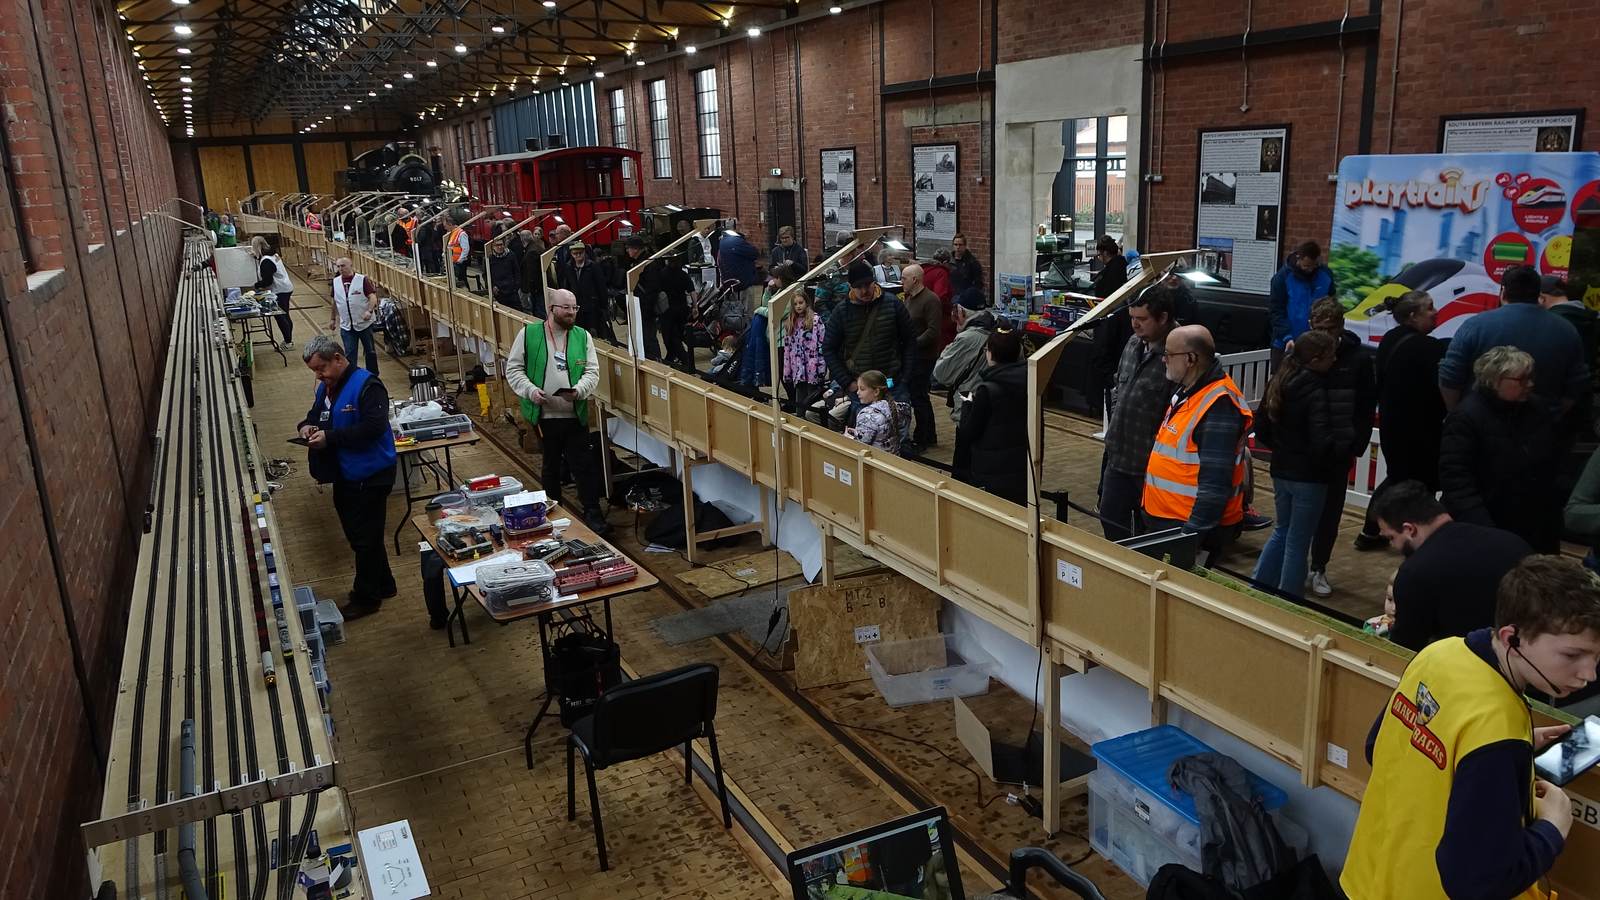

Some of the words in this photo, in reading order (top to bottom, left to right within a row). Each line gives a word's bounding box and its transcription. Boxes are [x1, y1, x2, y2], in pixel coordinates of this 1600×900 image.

[1392, 698, 1417, 726] MAKI
[1412, 726, 1444, 764] RACKS
[112, 823, 119, 834] 1
[143, 814, 150, 826] 2
[176, 807, 185, 818] 3
[198, 800, 207, 812] 4
[231, 793, 239, 804] 5
[252, 786, 261, 798] 6
[286, 779, 295, 791] 7
[315, 772, 323, 783] 8
